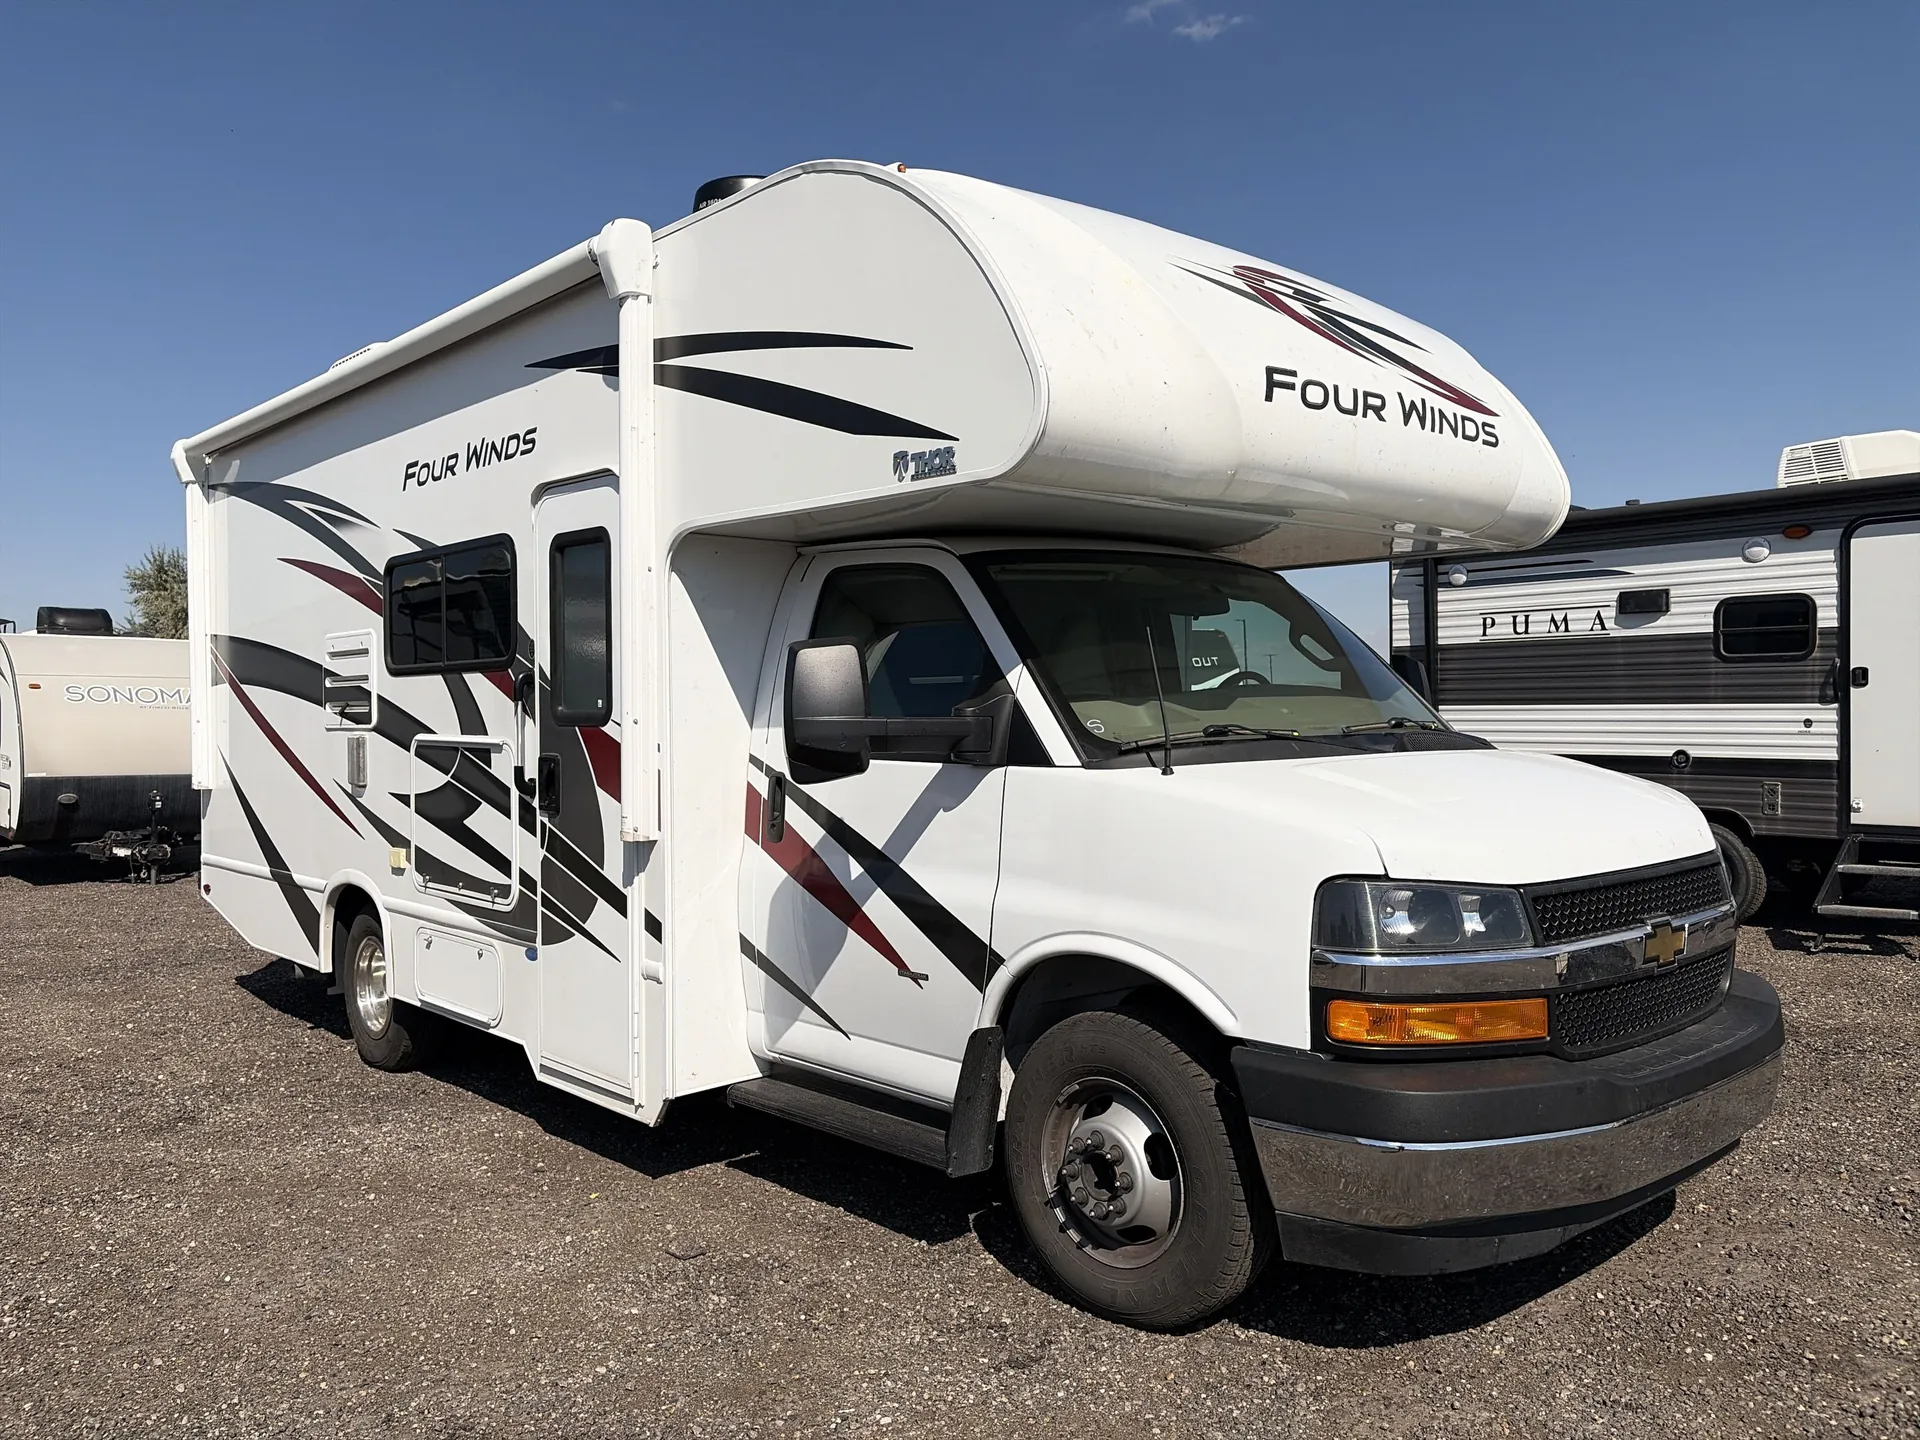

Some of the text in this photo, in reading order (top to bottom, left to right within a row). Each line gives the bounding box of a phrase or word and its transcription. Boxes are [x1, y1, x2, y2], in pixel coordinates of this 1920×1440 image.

[1264, 365, 1499, 448] FOUR WINDS
[402, 427, 537, 492] FOUR WINDS
[910, 446, 956, 474] THOR
[1481, 609, 1608, 637] PUMA
[1191, 656, 1218, 667] OUT
